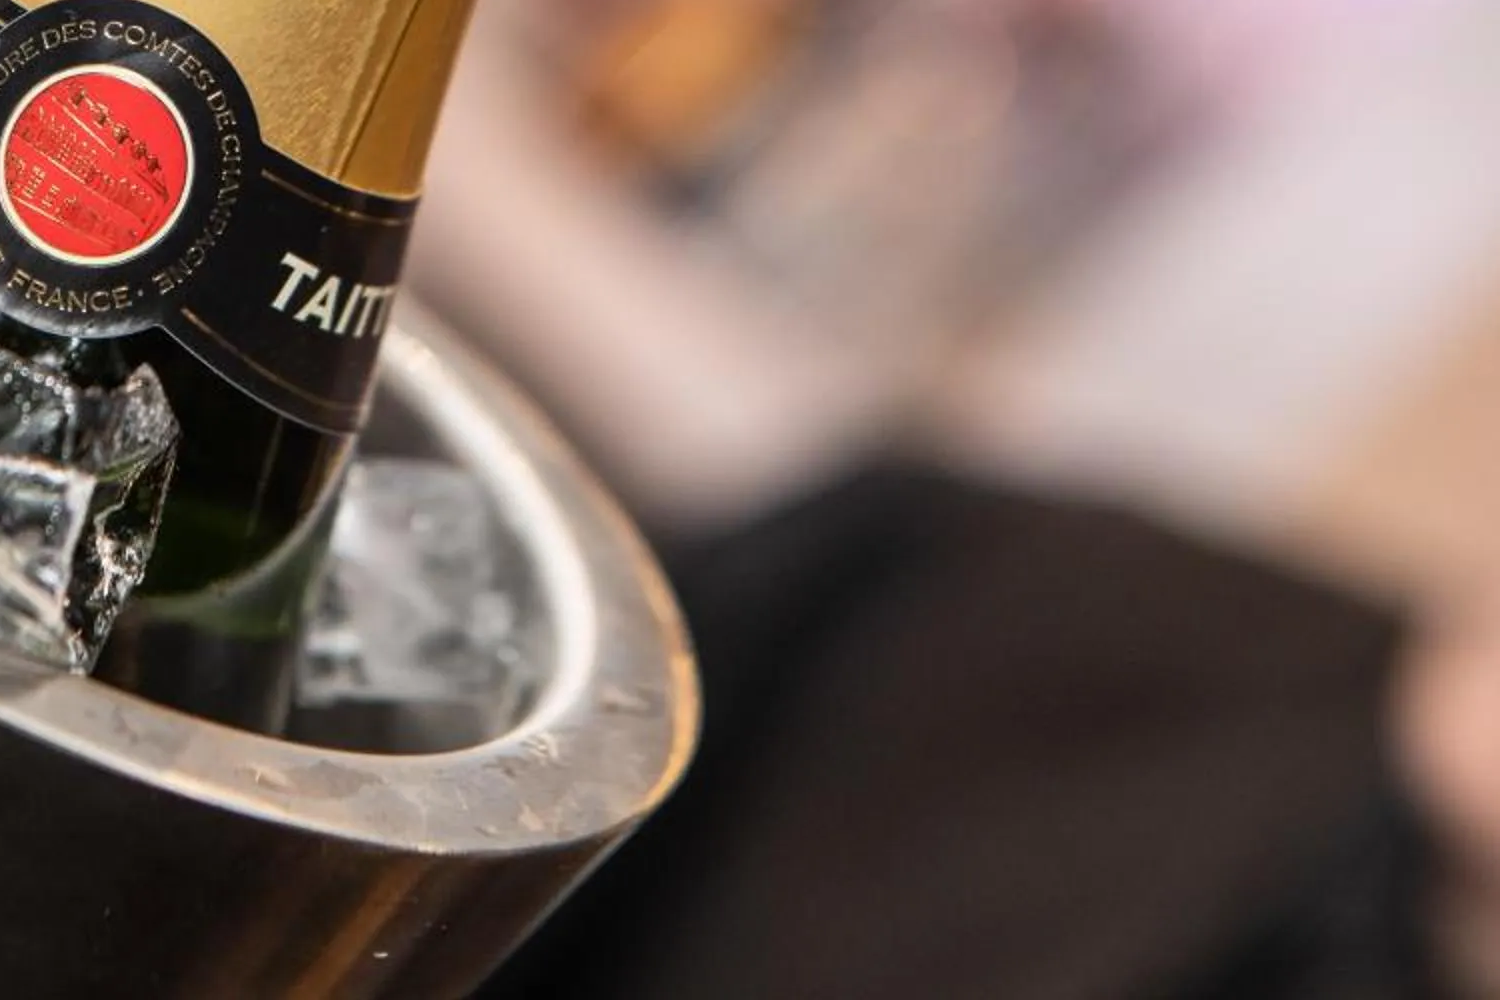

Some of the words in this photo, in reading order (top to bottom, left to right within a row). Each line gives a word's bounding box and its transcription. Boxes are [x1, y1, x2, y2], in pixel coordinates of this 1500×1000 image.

[41, 19, 97, 50] DES
[103, 20, 215, 91] COMTES
[207, 90, 237, 130] DE
[152, 134, 241, 295] CHAMPAGNE
[7, 269, 133, 313] FRANCE
